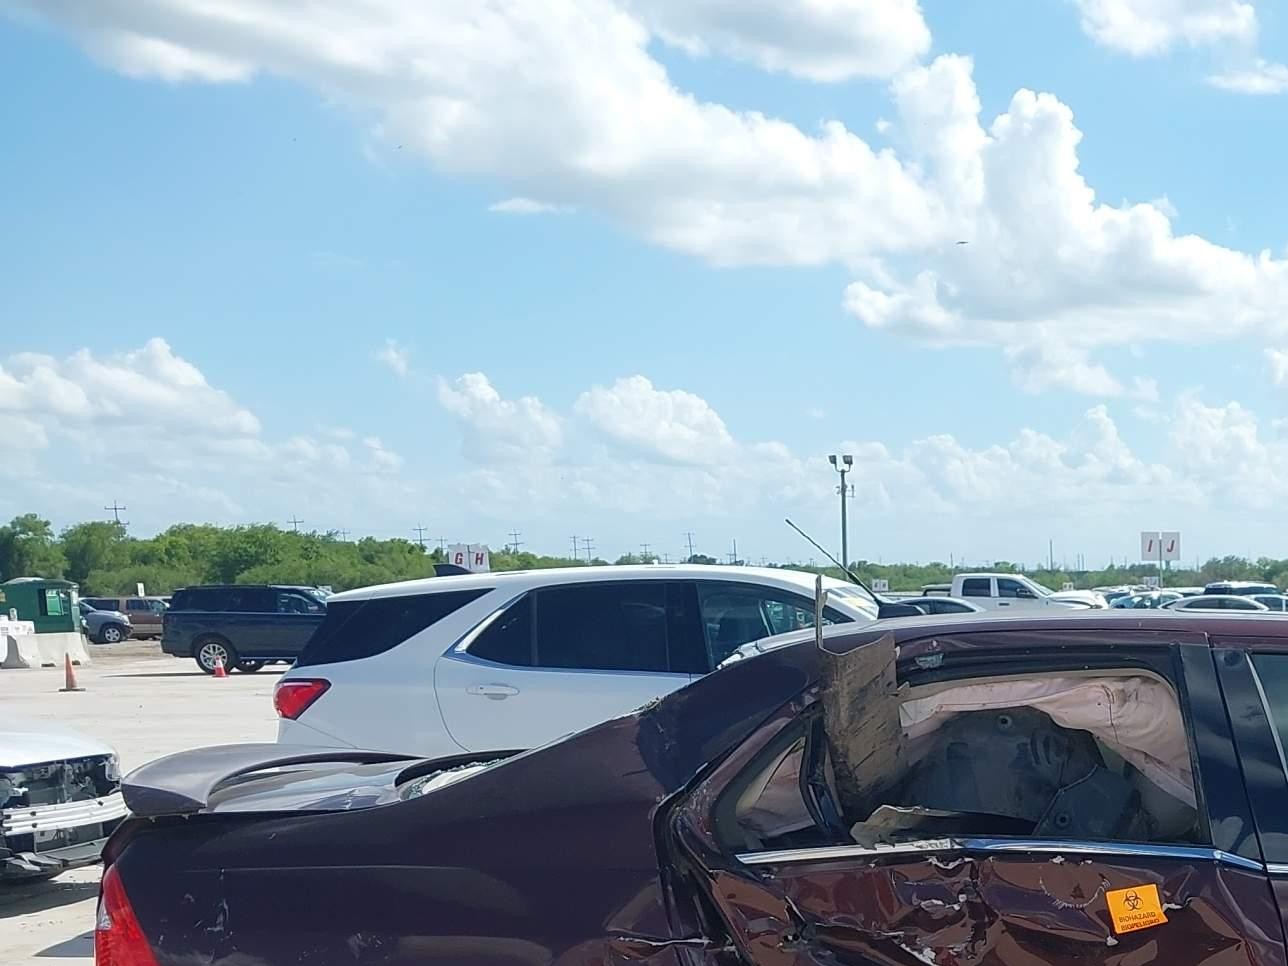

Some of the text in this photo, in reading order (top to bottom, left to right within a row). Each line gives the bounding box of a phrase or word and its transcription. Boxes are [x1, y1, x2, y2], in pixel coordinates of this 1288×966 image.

[1166, 539, 1175, 553] J
[454, 552, 484, 565] G H
[1118, 911, 1156, 923] BIOHAZARD
